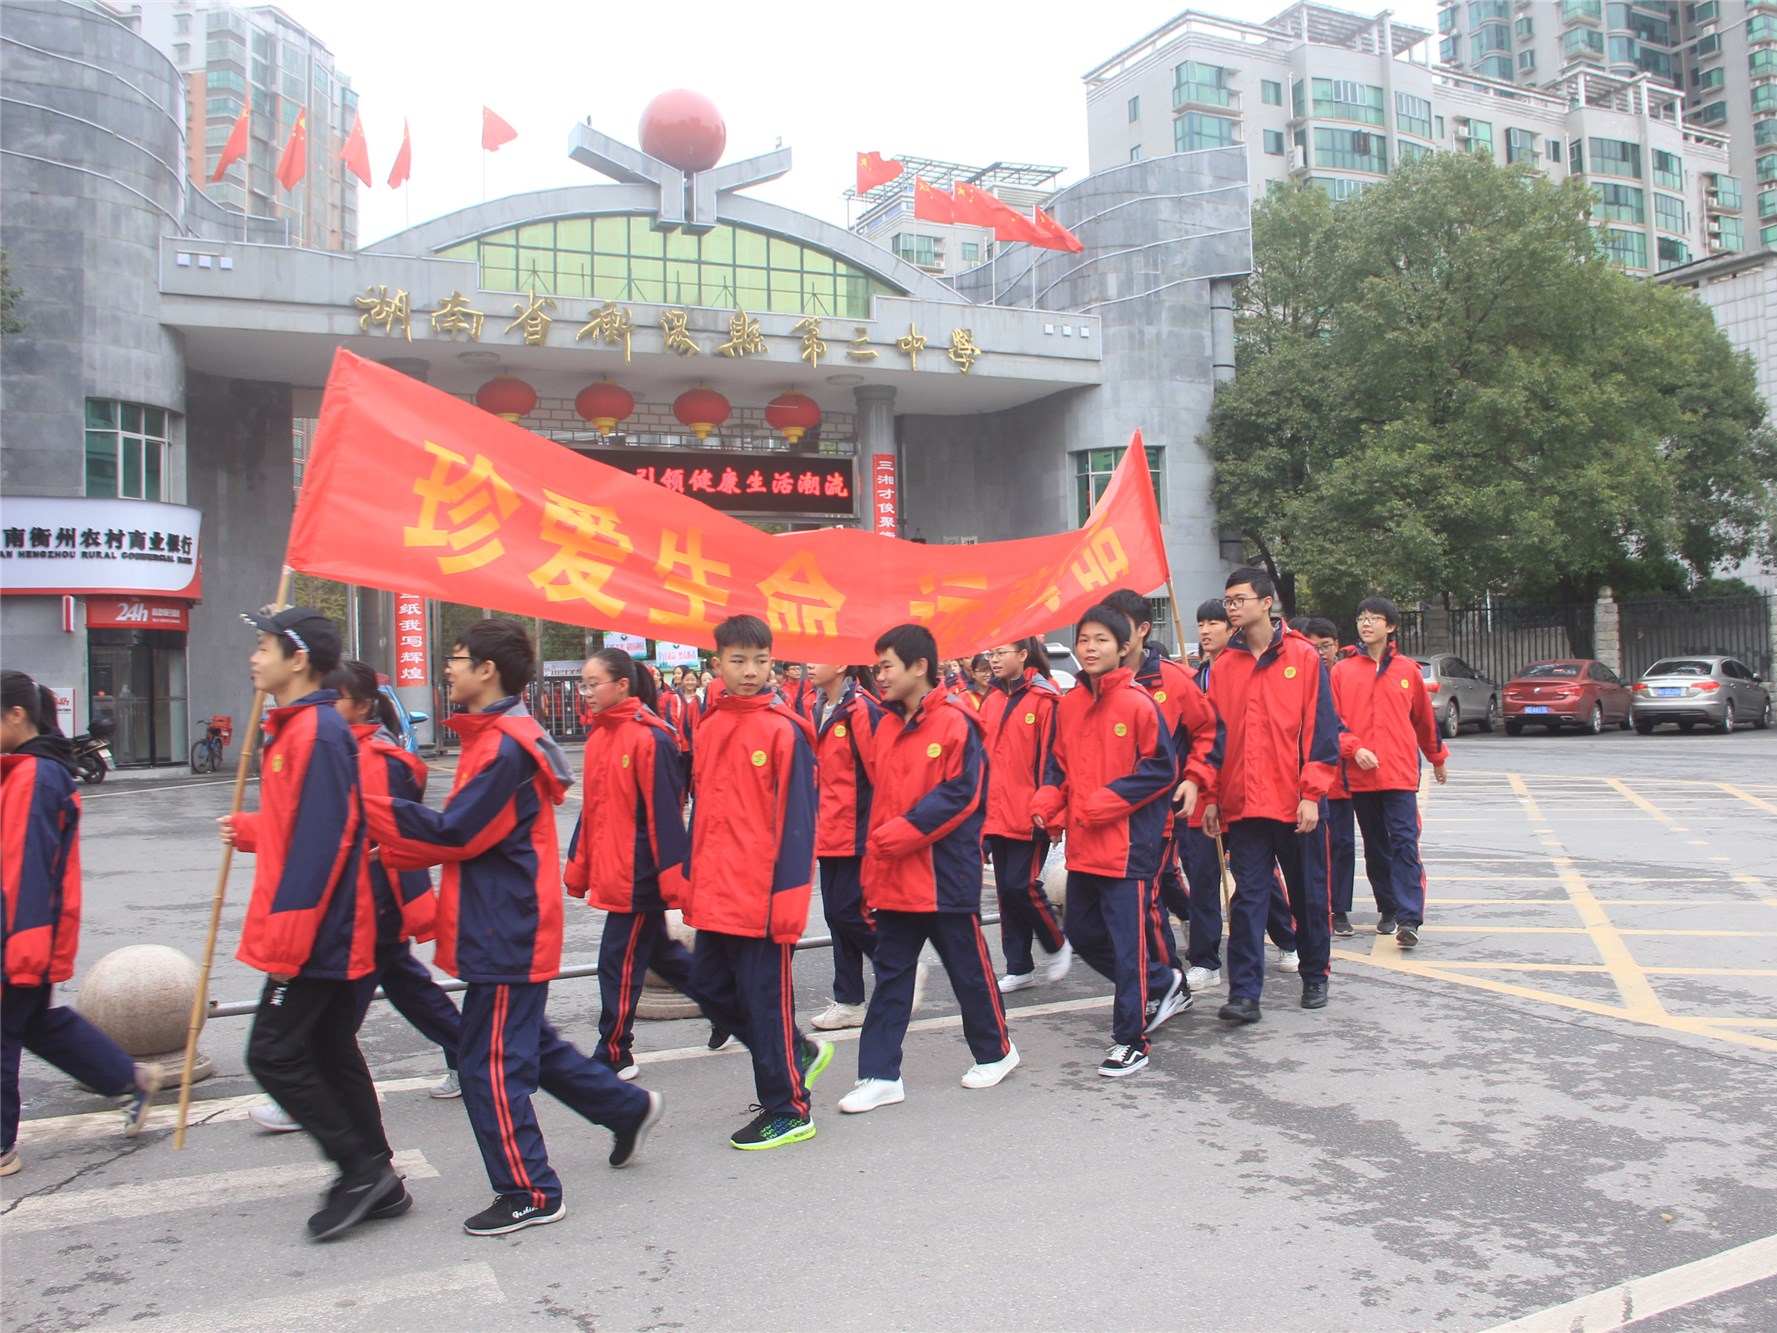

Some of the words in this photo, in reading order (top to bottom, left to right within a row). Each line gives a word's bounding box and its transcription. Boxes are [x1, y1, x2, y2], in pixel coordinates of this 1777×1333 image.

[634, 466, 849, 498] 引领健康生活潮流
[3, 527, 193, 556] 南衡州农村商业银行
[403, 440, 847, 638] 珍爱生命
[81, 551, 117, 560] RURAL
[115, 602, 149, 622] 24h
